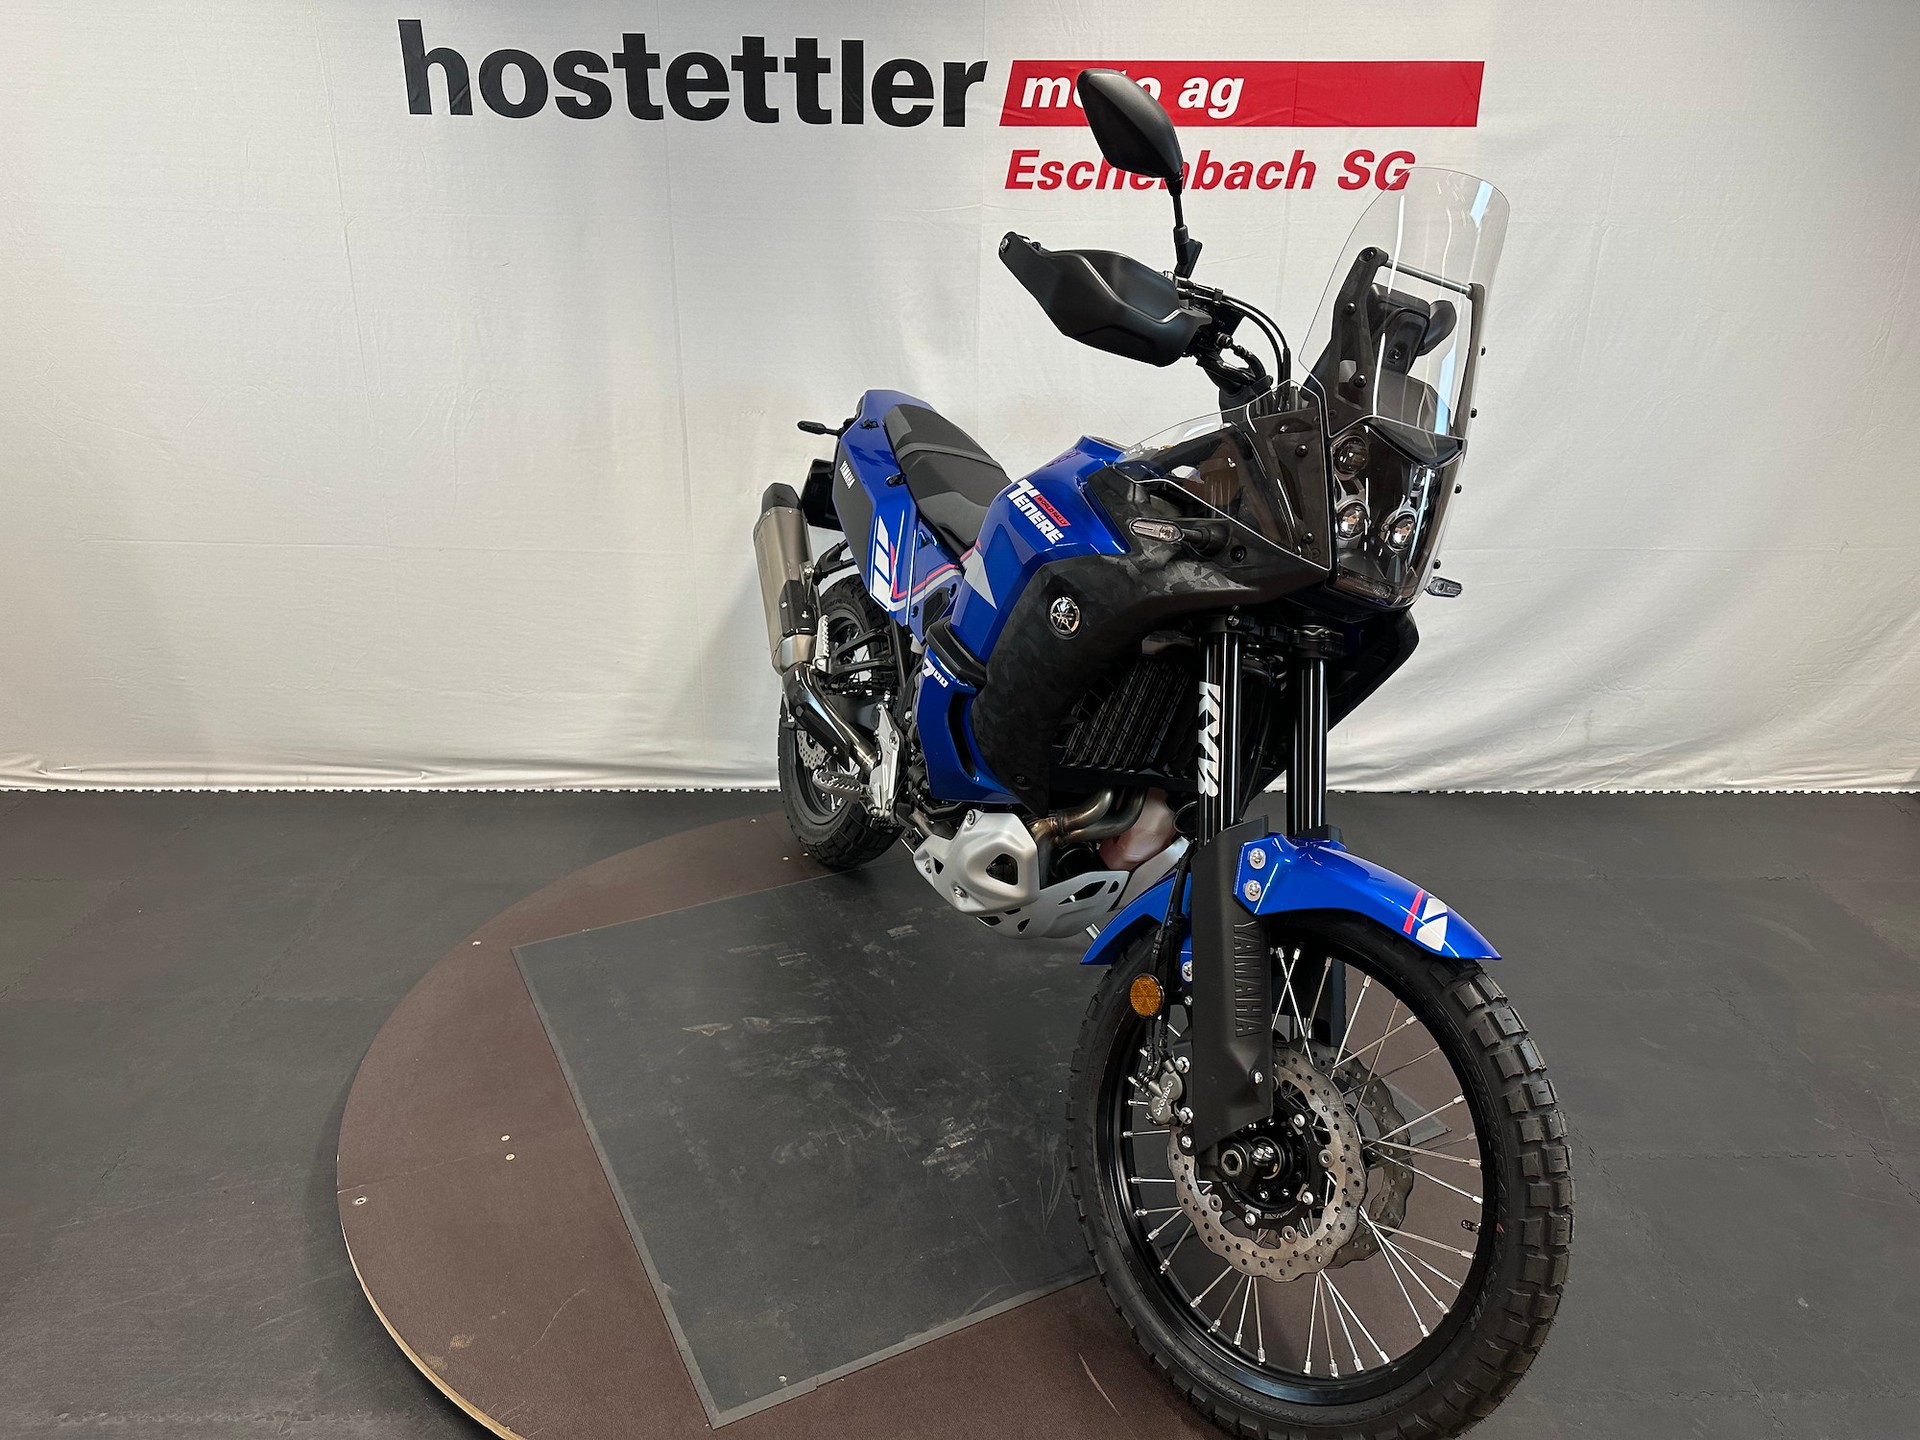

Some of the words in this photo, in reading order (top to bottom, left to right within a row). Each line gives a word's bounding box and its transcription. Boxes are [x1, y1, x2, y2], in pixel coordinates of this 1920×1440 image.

[397, 19, 988, 127] hostettler
[1021, 70, 1162, 108] mo
[1178, 76, 1244, 119] ag
[1004, 149, 1317, 190] Eschebach
[1337, 149, 1416, 191] SG
[839, 460, 856, 489] YAMAHA
[1037, 496, 1053, 513] WORLD
[1052, 511, 1068, 525] RALLY
[922, 658, 949, 688] 700
[1197, 680, 1221, 798] KYB
[1234, 920, 1263, 1038] YAMAHA
[1153, 1080, 1174, 1117] brembo
